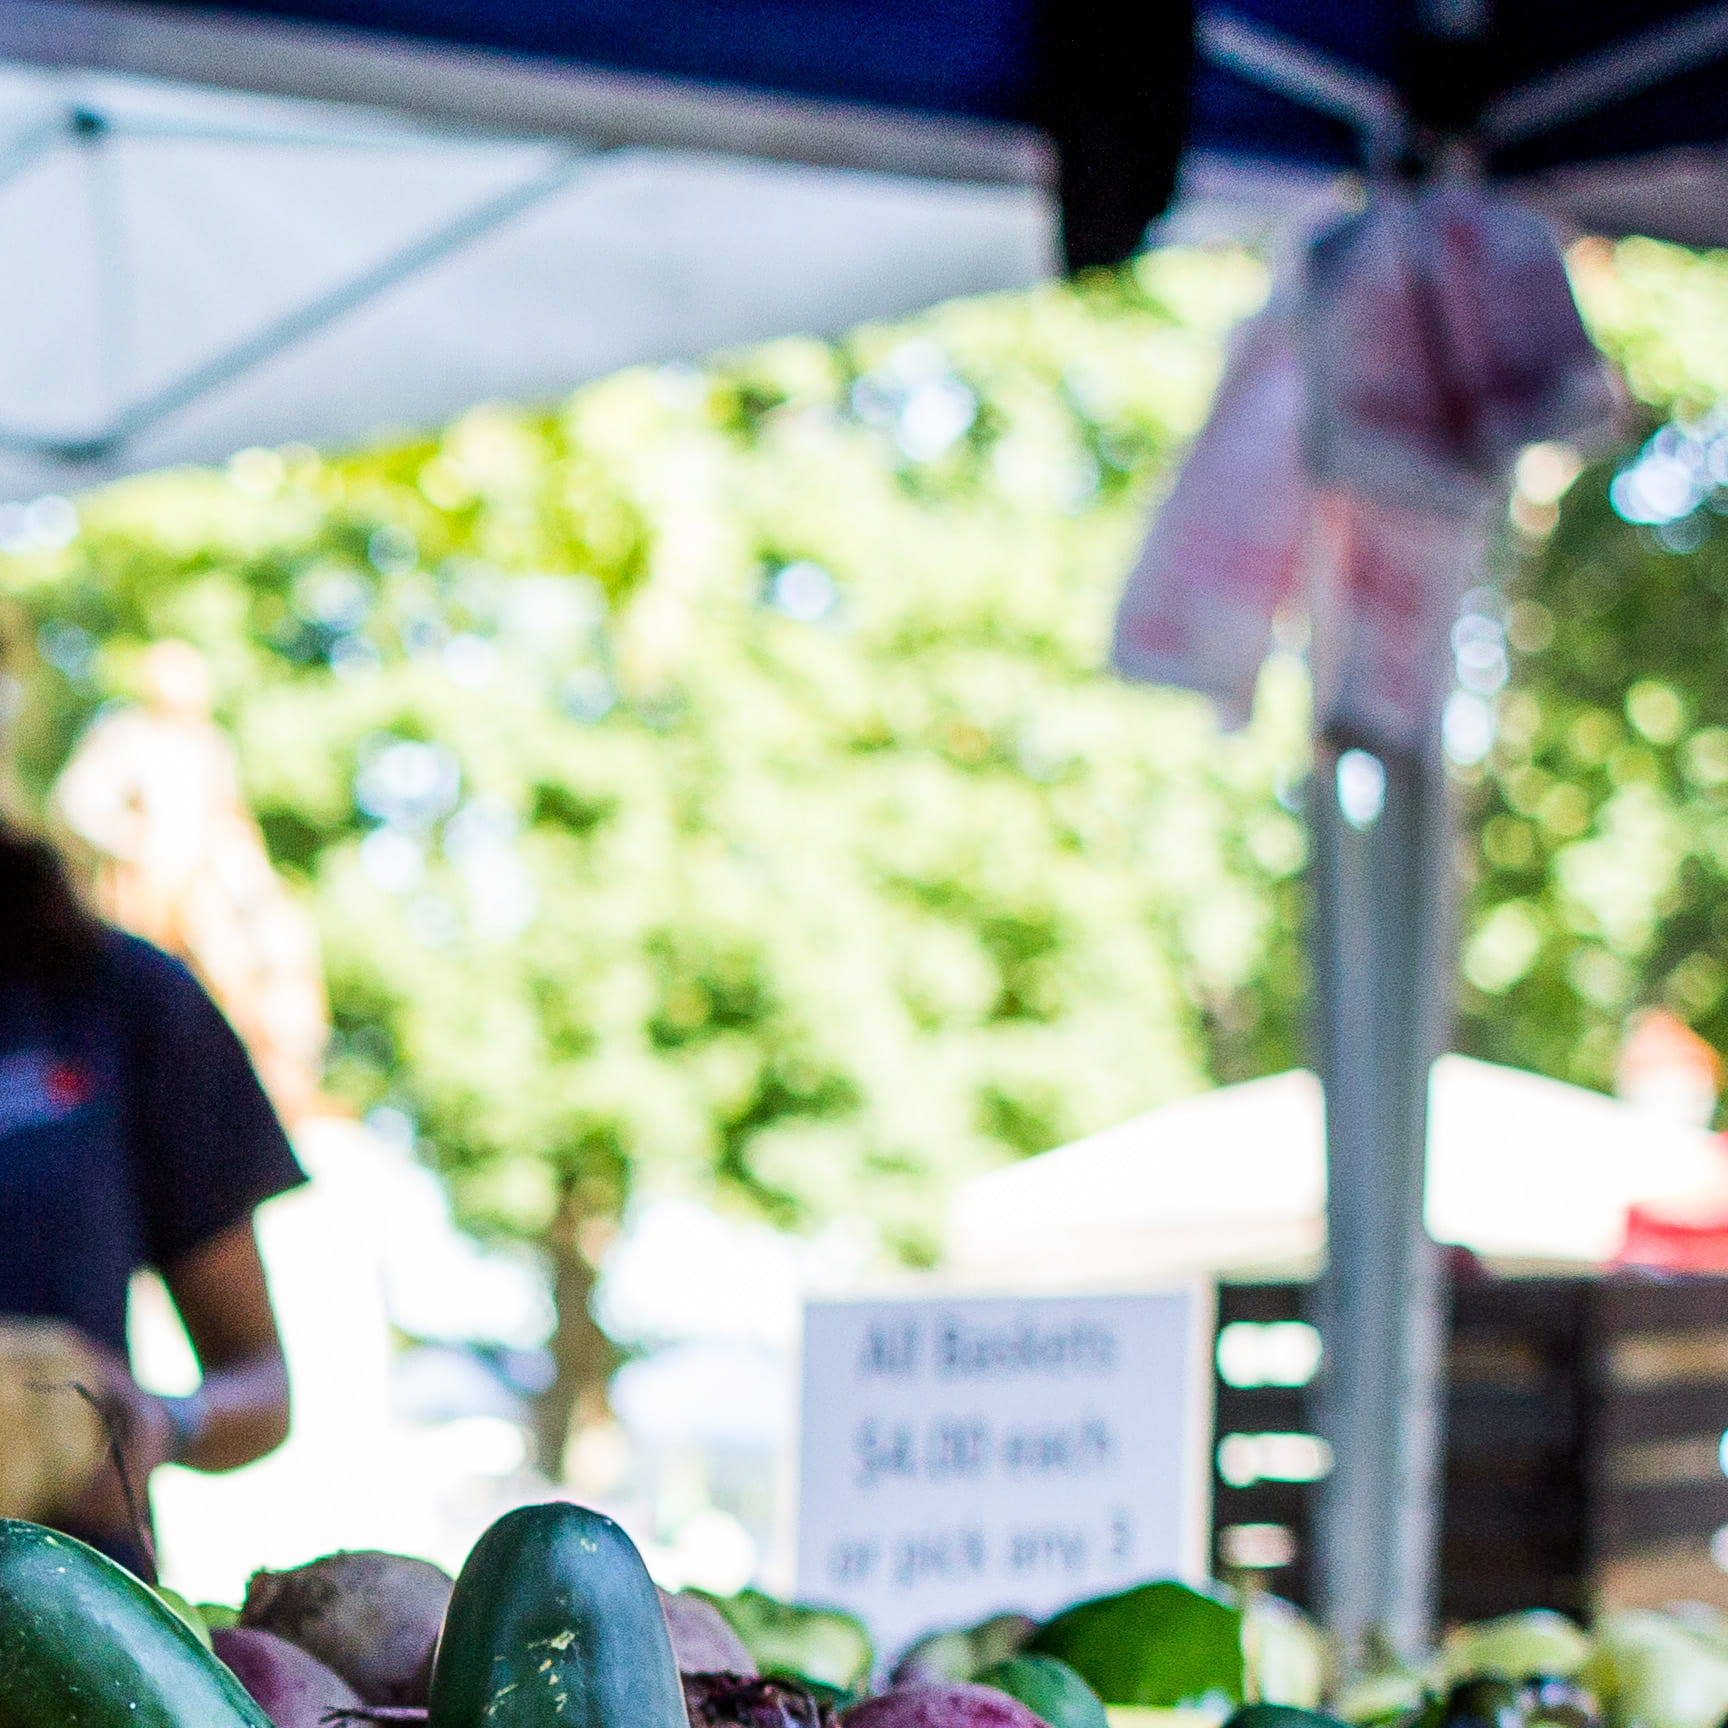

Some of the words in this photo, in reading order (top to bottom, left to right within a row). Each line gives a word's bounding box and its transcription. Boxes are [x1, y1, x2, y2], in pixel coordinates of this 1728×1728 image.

[857, 1318, 922, 1376] All
[936, 1315, 1118, 1377] Baskets
[854, 1414, 991, 1488] $4.00
[1003, 1411, 1115, 1476] each
